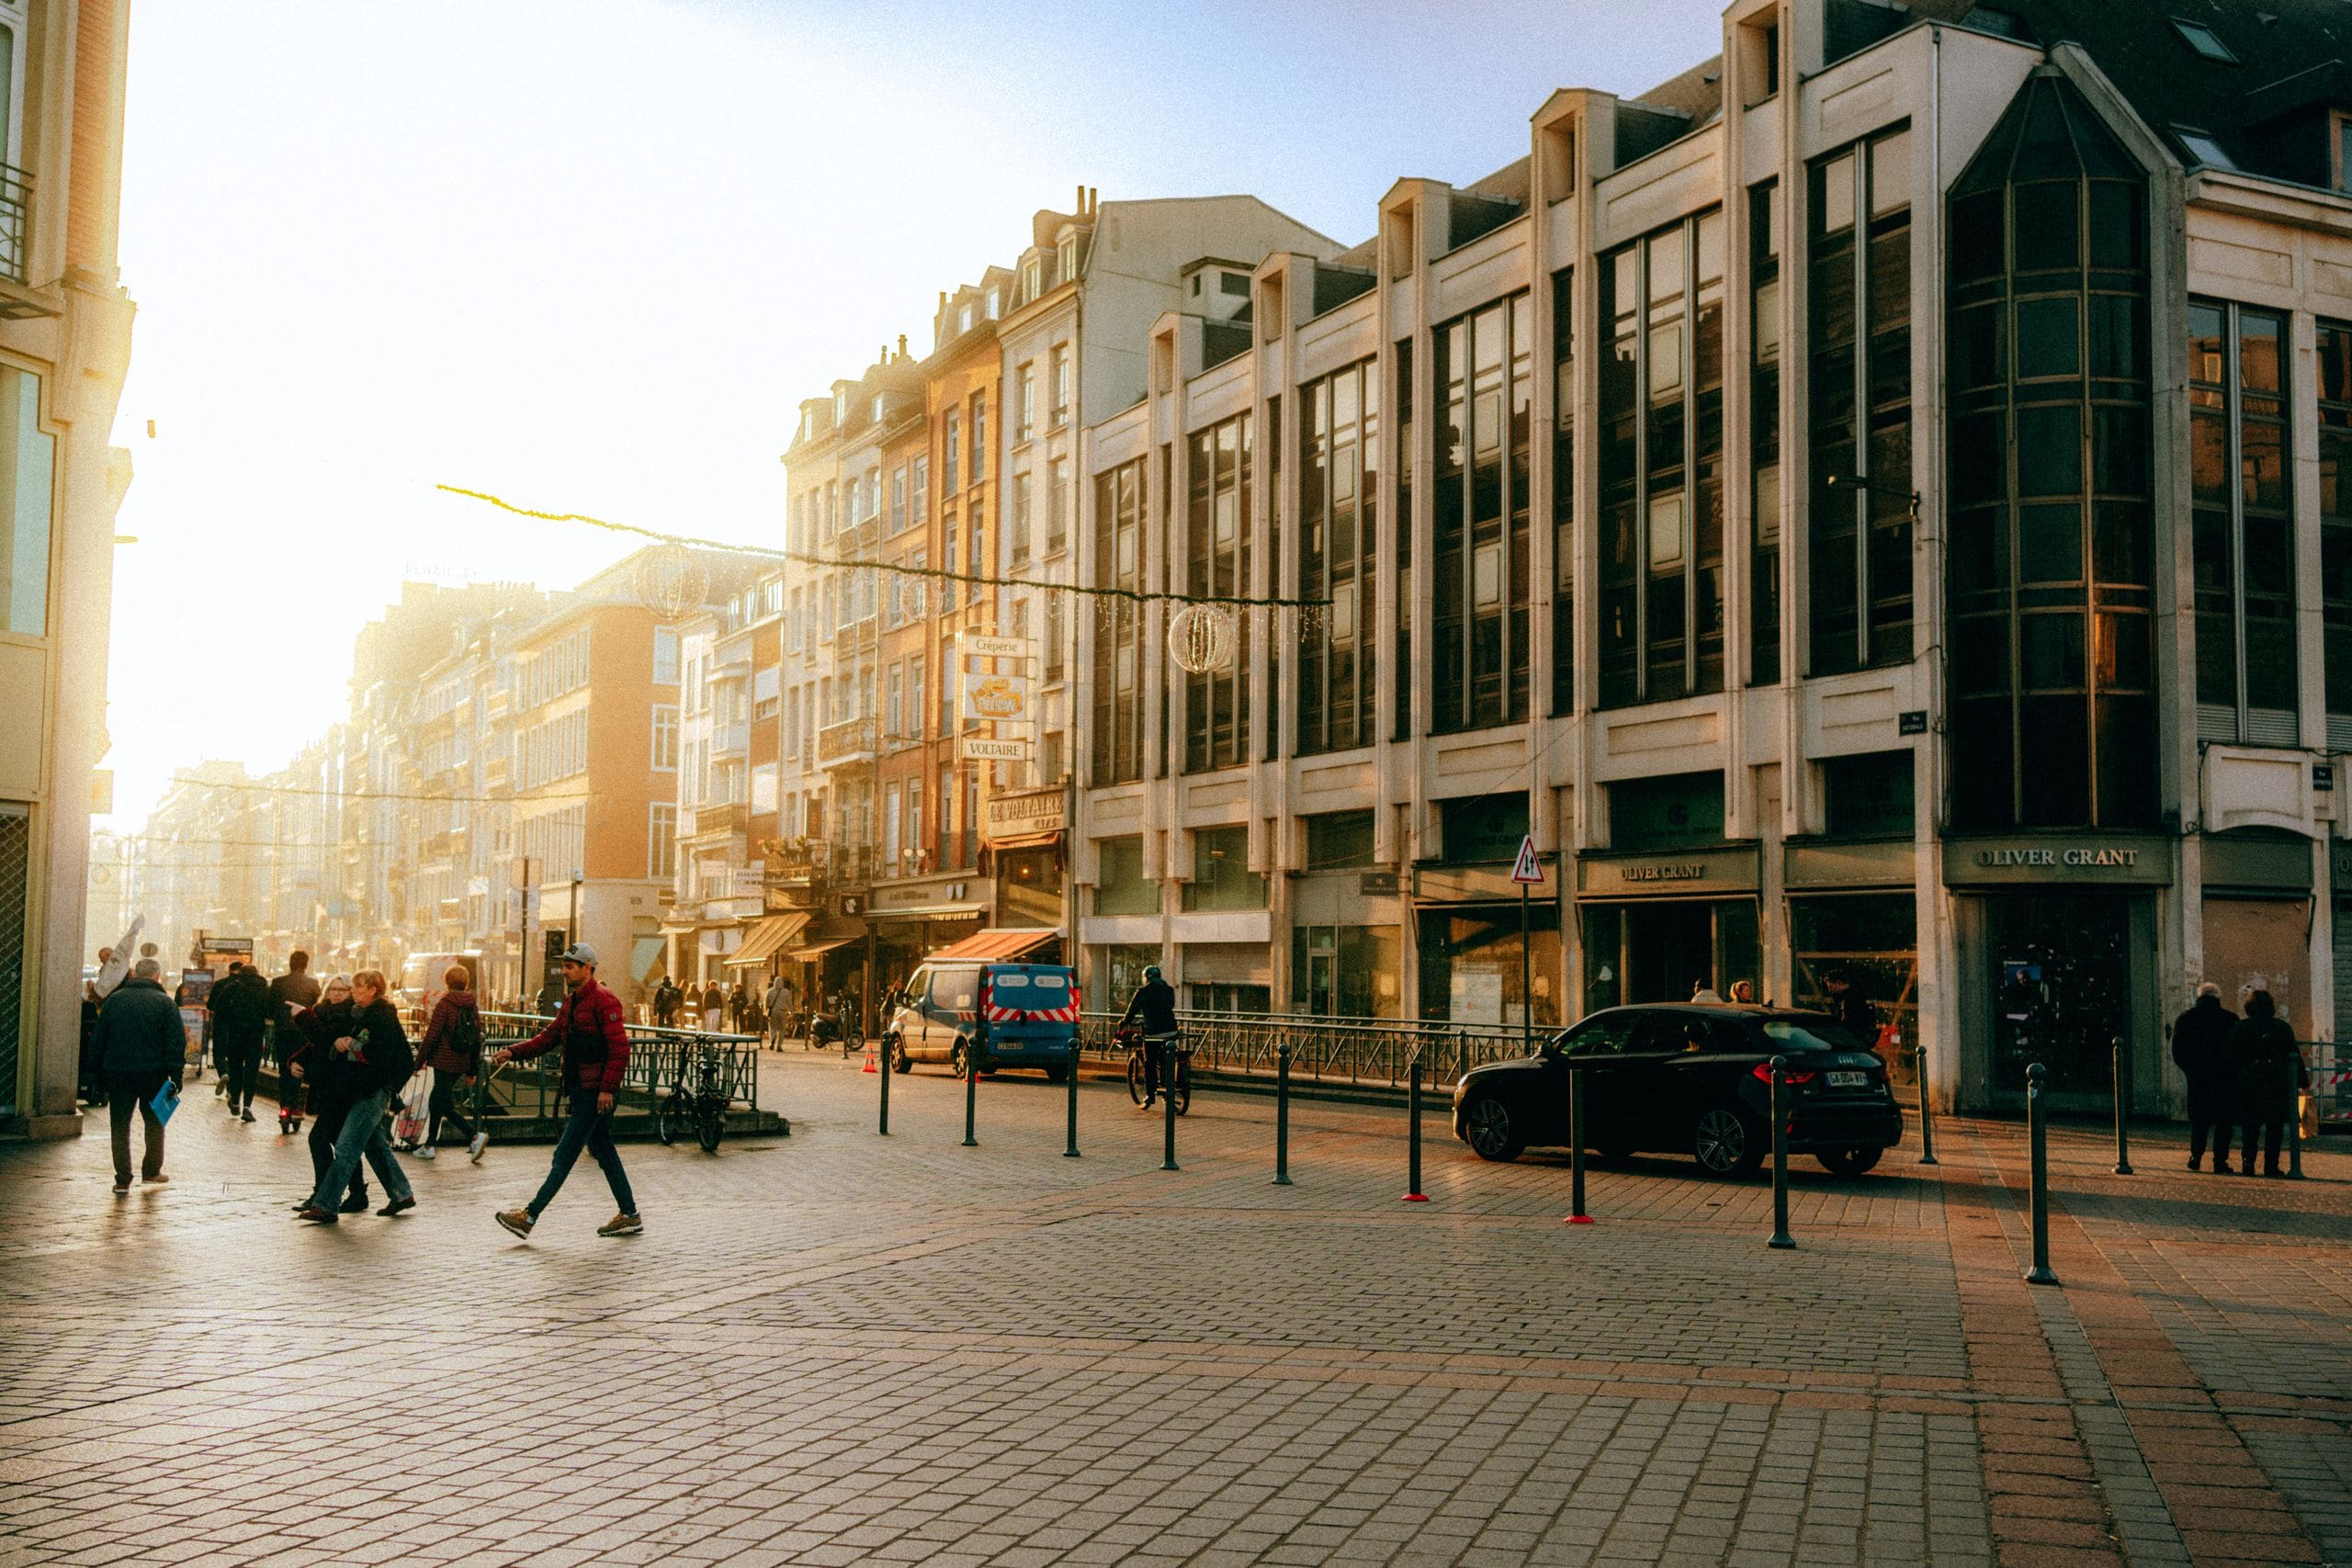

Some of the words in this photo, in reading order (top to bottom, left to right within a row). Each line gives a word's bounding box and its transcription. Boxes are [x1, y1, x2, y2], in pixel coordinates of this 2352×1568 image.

[970, 742, 1021, 757] VOLTAIRE
[990, 802, 1003, 823] LE
[1006, 793, 1063, 820] VOLTAIRE
[1978, 849, 2056, 867] OLIVER
[2063, 848, 2139, 866] GRANT
[1621, 866, 1660, 882] OLIVER
[1661, 863, 1704, 879] GRANT
